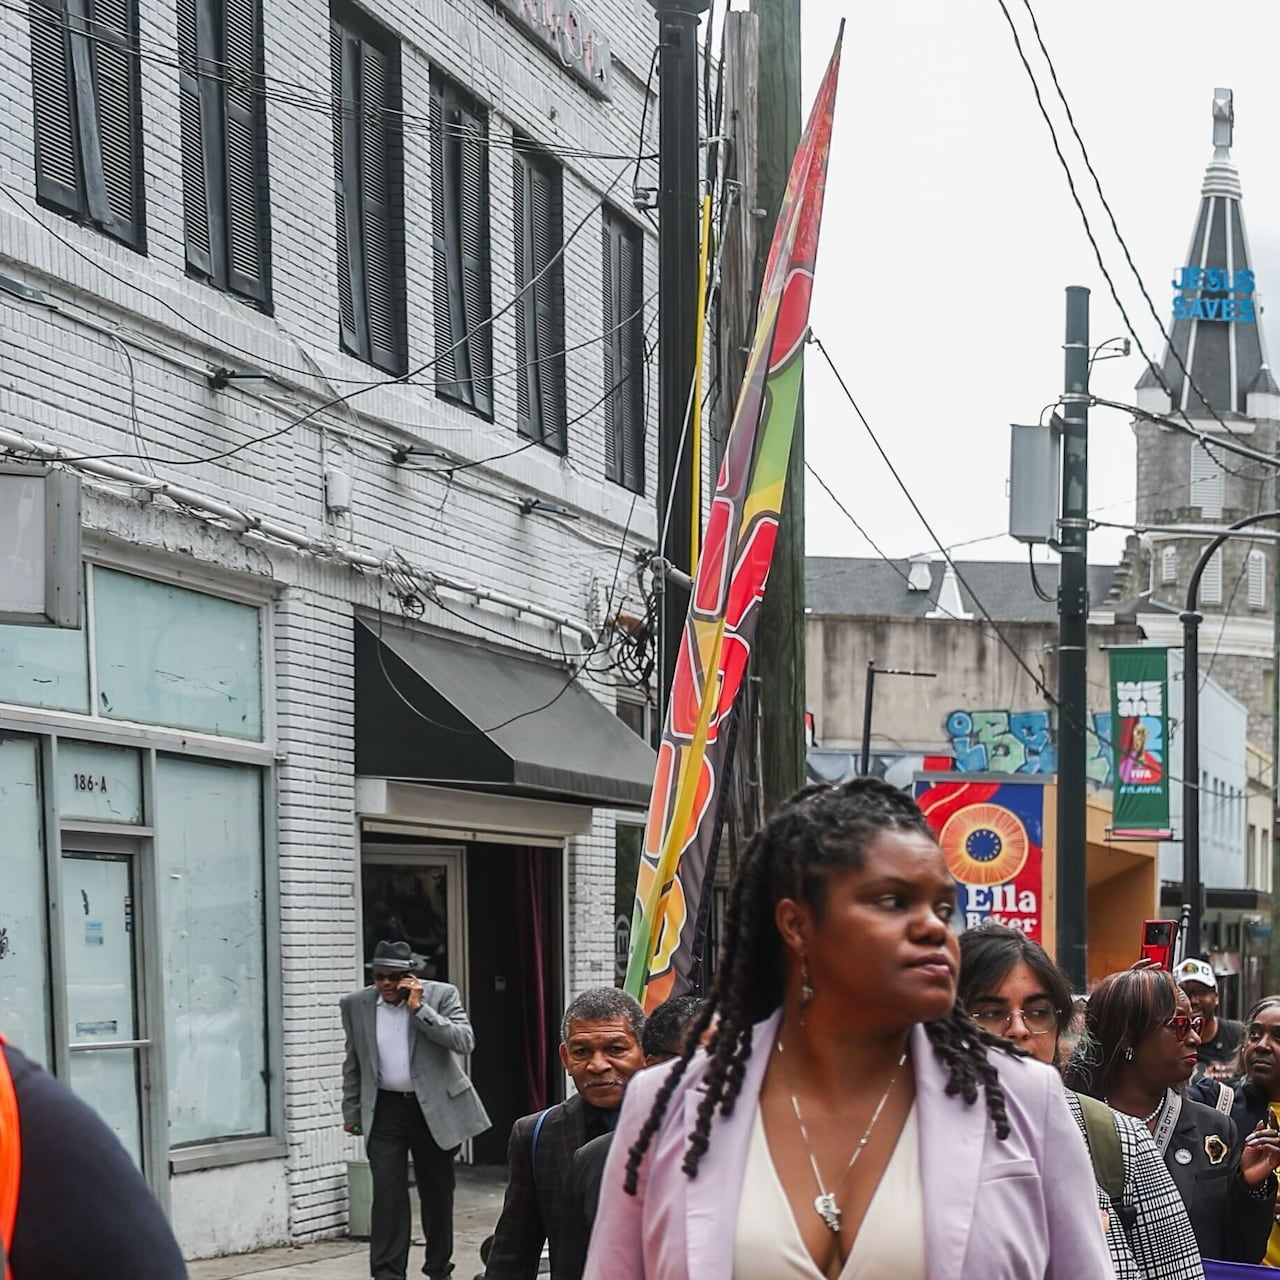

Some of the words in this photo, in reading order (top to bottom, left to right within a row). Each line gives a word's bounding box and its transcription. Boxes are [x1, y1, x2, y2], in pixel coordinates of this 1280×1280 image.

[1171, 267, 1255, 293] JESUS
[1172, 295, 1254, 323] SAVES
[1130, 768, 1151, 779] FIFA
[1119, 785, 1163, 794] ATLANTA
[965, 884, 1037, 913] Ella
